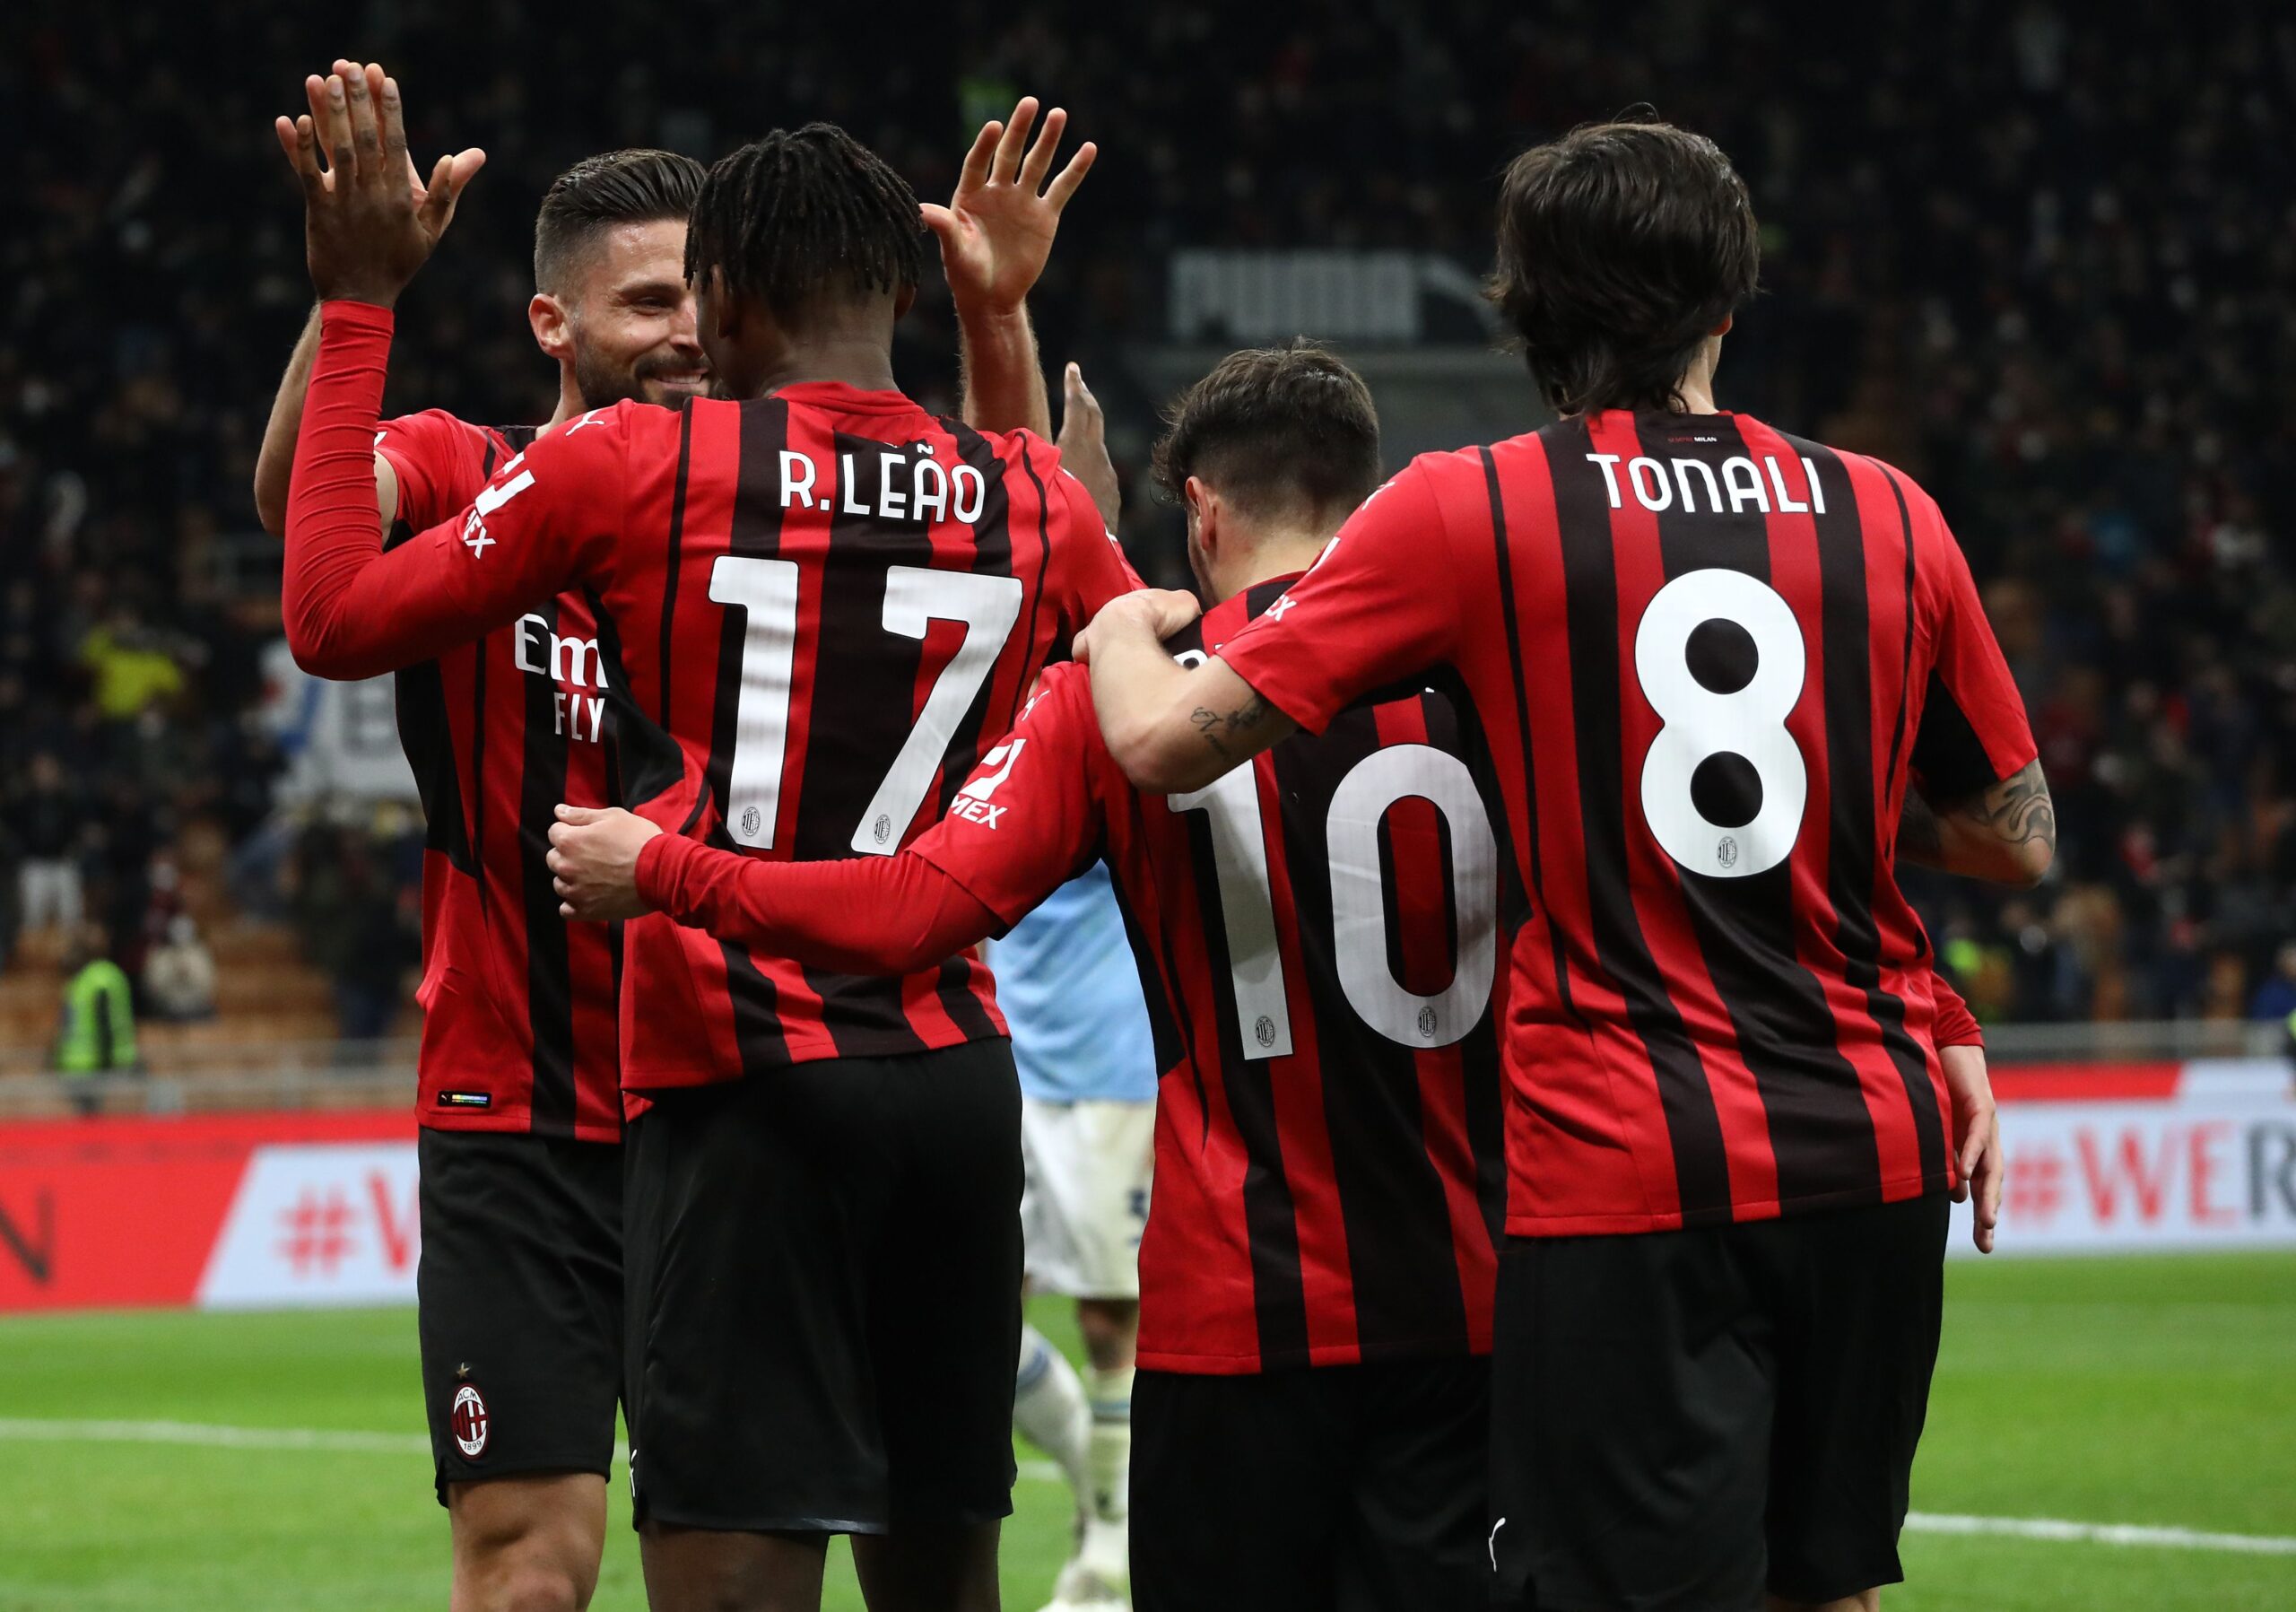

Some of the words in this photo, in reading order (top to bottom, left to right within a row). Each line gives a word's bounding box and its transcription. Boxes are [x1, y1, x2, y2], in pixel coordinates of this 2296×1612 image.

[778, 443, 987, 524] R.LEÃO
[1585, 453, 1826, 515] TONALI
[553, 692, 605, 744] FLY
[708, 555, 1023, 857] 17
[1634, 568, 1807, 878] 8
[1167, 744, 1498, 1060] 10
[464, 1440, 483, 1451] 1899
